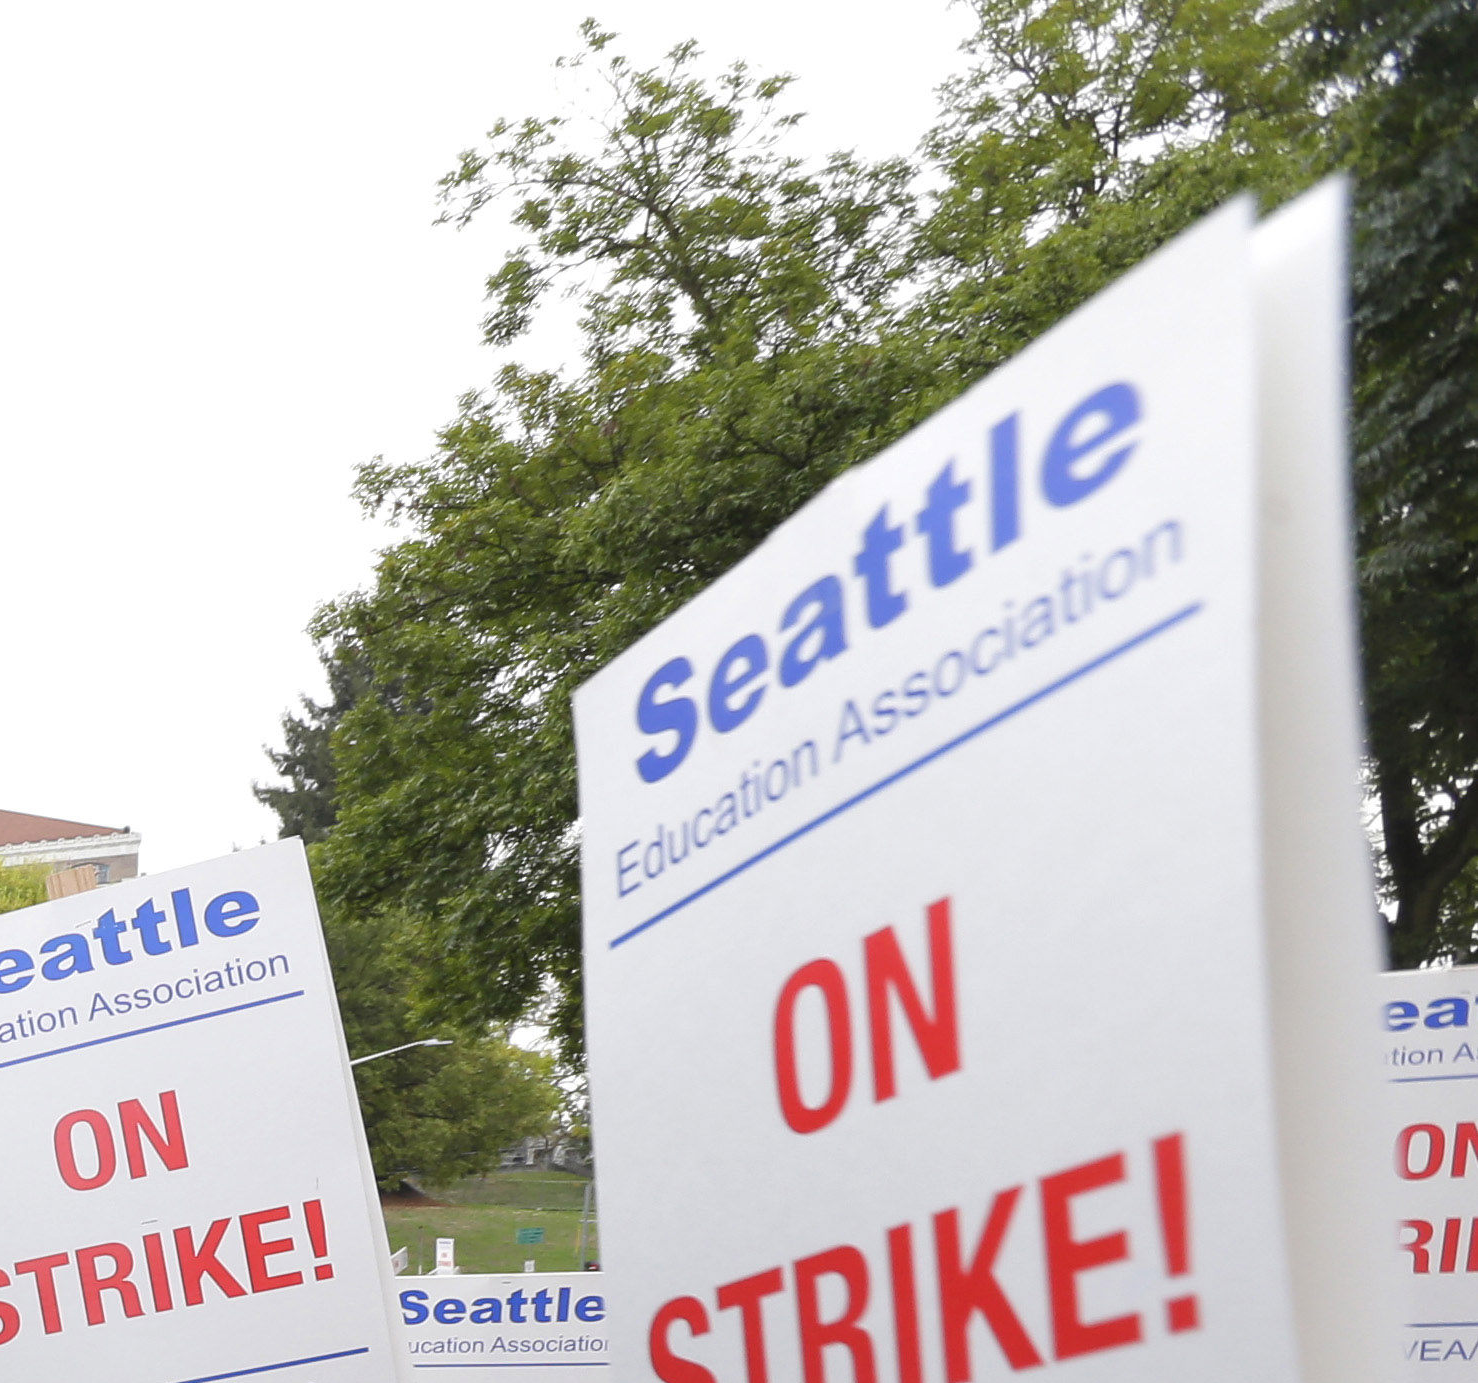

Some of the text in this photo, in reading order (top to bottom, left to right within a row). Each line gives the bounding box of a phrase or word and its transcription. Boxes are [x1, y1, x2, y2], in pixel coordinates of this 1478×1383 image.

[634, 381, 1146, 785] Seattle
[616, 518, 1186, 897] Education Association
[88, 953, 291, 1022] Association
[773, 896, 964, 1136] ON
[54, 1090, 190, 1192] ON
[399, 1287, 607, 1326] Seattle
[407, 1337, 485, 1354] ucation
